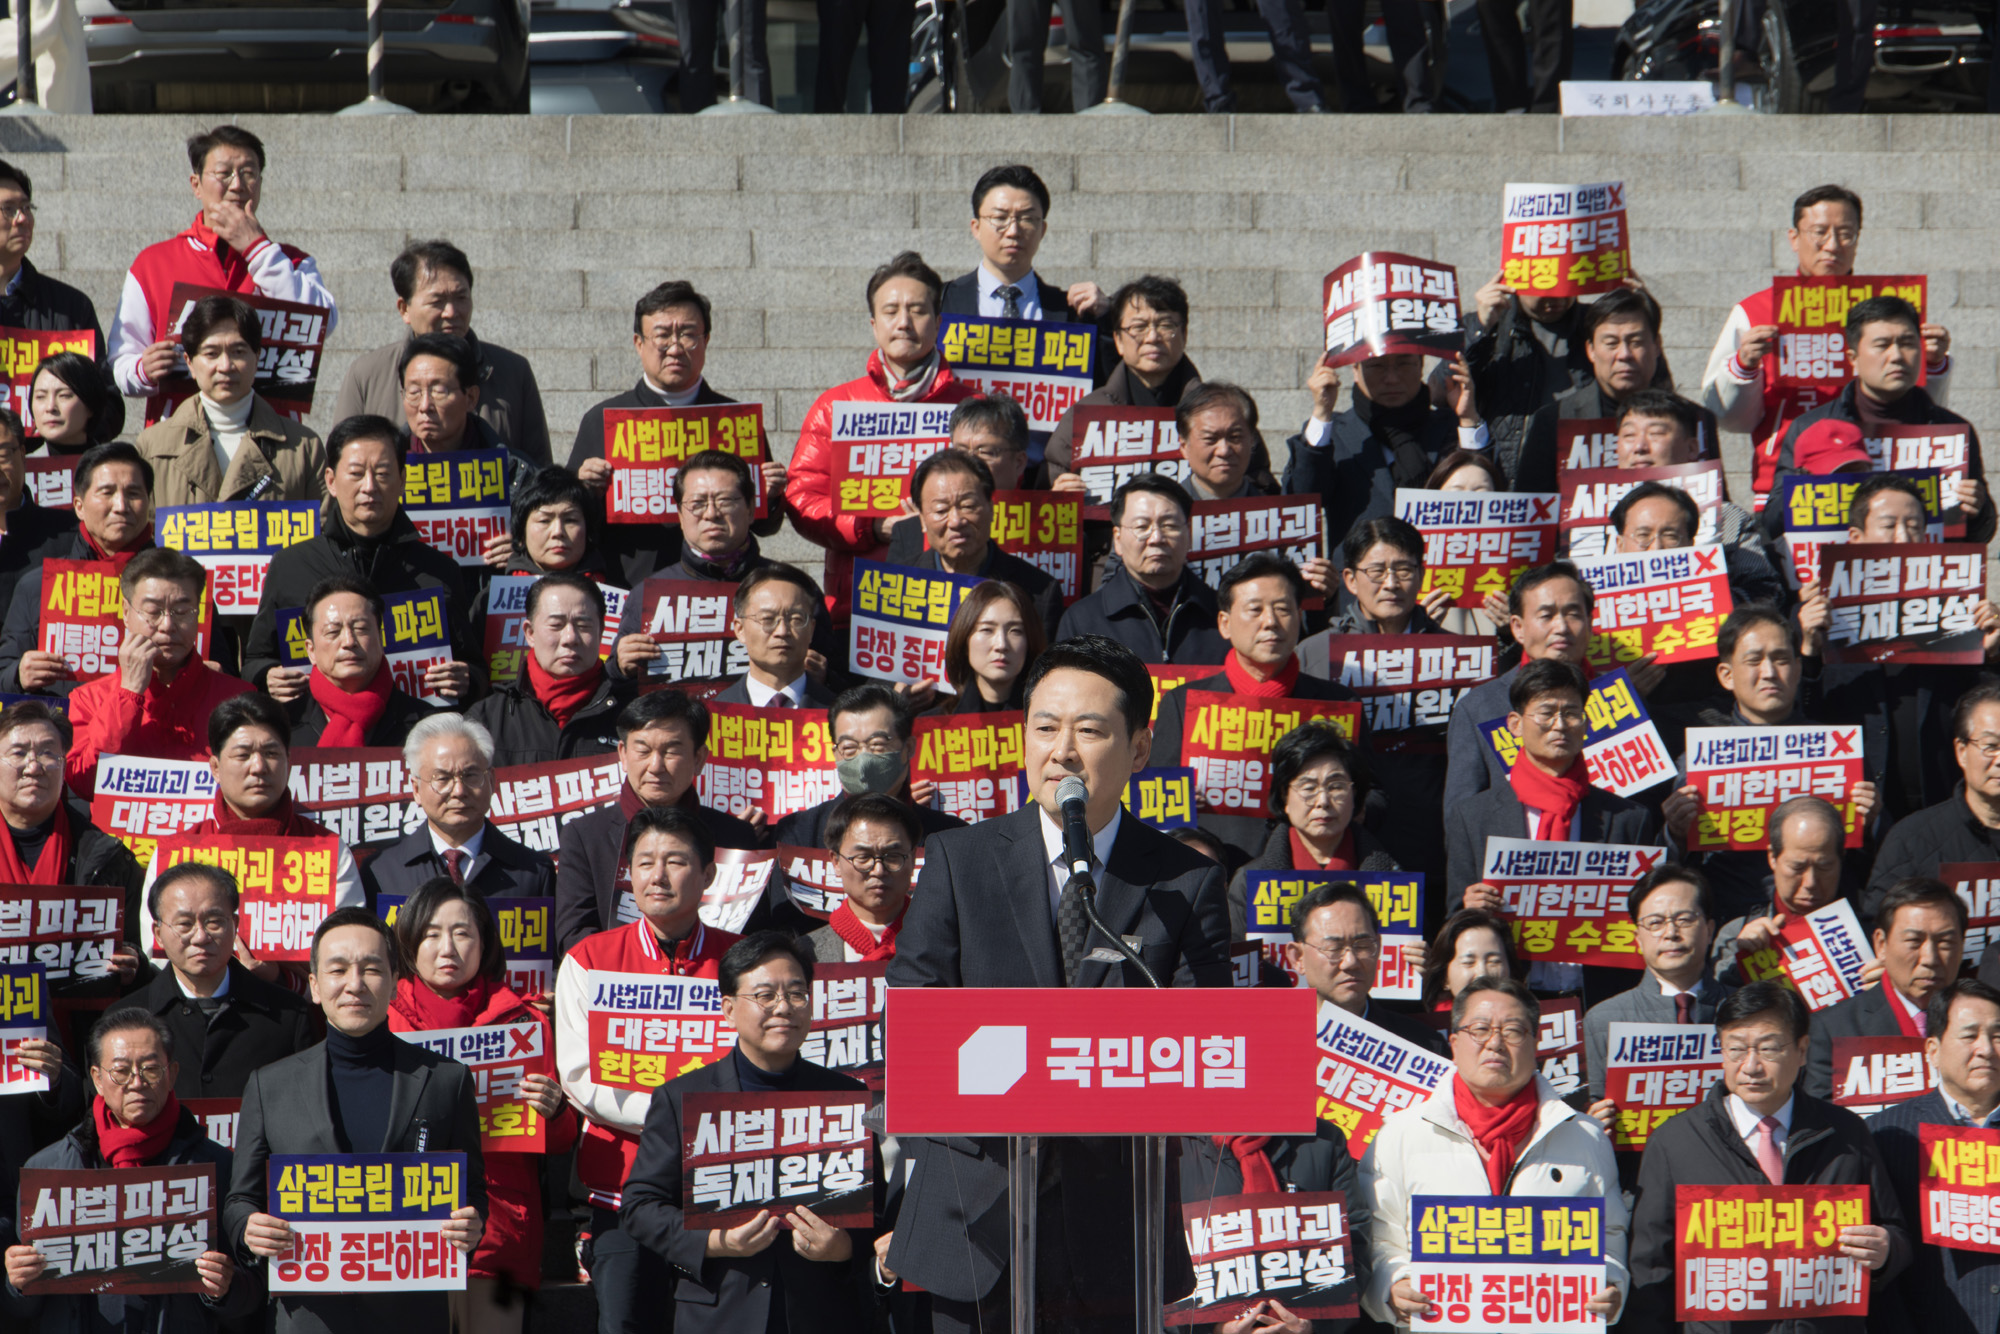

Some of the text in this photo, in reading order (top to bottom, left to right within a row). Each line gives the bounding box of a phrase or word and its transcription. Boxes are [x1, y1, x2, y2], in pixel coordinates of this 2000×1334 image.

[1509, 193, 1570, 218] 사법파괴
[1511, 217, 1620, 257] 대한민국
[1328, 263, 1456, 316] 사법 파괴
[1503, 250, 1628, 290] 헌정 수호!
[943, 322, 1091, 373] 삼권분립 파괴
[1326, 298, 1459, 351] 독재 완성
[1779, 333, 1844, 379] 대통령은
[611, 414, 759, 462] 사법파괴 3법
[837, 412, 916, 436] 사법파괴
[1080, 420, 1154, 459] 사법
[1895, 434, 1967, 469] 파괴
[458, 458, 504, 502] 파괴
[840, 478, 902, 512] 헌정
[161, 509, 315, 551] 삼권분립 파괴
[1038, 502, 1078, 545] 3법
[1192, 504, 1320, 552] 법 파괴
[1403, 499, 1528, 525] 사법파괴 악법
[1650, 553, 1690, 580] 악법
[1829, 554, 1984, 598] 사법 파괴
[391, 596, 444, 644] 파괴
[652, 596, 728, 634] 사법
[857, 570, 953, 625] 삼권분립
[1592, 582, 1714, 629] 대한민국
[1828, 594, 1980, 647] 독재 완성
[45, 623, 119, 674] 대통령은
[856, 625, 896, 674] 당장
[1340, 645, 1494, 688] 사법 파괴
[1583, 678, 1641, 733] 파괴
[918, 724, 1024, 774] 사법파괴
[1694, 732, 1826, 765] 사법파괴 악법
[101, 766, 189, 795] 사법파괴
[288, 762, 359, 802] 사법
[485, 775, 554, 818] 사법
[1139, 777, 1191, 823] 파괴
[1707, 765, 1846, 807] 대한민국
[1698, 808, 1765, 846] 헌정
[282, 849, 331, 895] 3법
[1490, 850, 1630, 876] 사법파괴 악법
[36, 898, 120, 935] 파괴
[1365, 881, 1418, 928] 파괴
[498, 907, 548, 953] 파괴
[593, 984, 684, 1011] 사법파괴
[460, 1031, 505, 1062] 악법
[598, 1051, 666, 1087] 헌정
[1046, 1035, 1246, 1089] 국민의힘
[1317, 1019, 1408, 1075] 사법파괴
[1613, 1033, 1704, 1063] 사법파괴
[1843, 1052, 1924, 1097] 사법
[691, 1104, 870, 1156] 사법 파괴
[30, 1176, 214, 1229] 사법 파괴
[277, 1162, 459, 1213] 삼권분립 파괴
[693, 1148, 865, 1212] 독재 완성
[1257, 1203, 1348, 1244] 파괴
[1418, 1206, 1599, 1257] 삼권분립 파괴
[1685, 1198, 1804, 1249] 사법파괴
[32, 1219, 208, 1279] 독재 완성
[340, 1230, 458, 1282] 중단하라!
[1260, 1245, 1347, 1291] 완성
[1419, 1273, 1597, 1324] 당장 중단하라!
[1685, 1255, 1862, 1312] 대통령은 거부하라!
